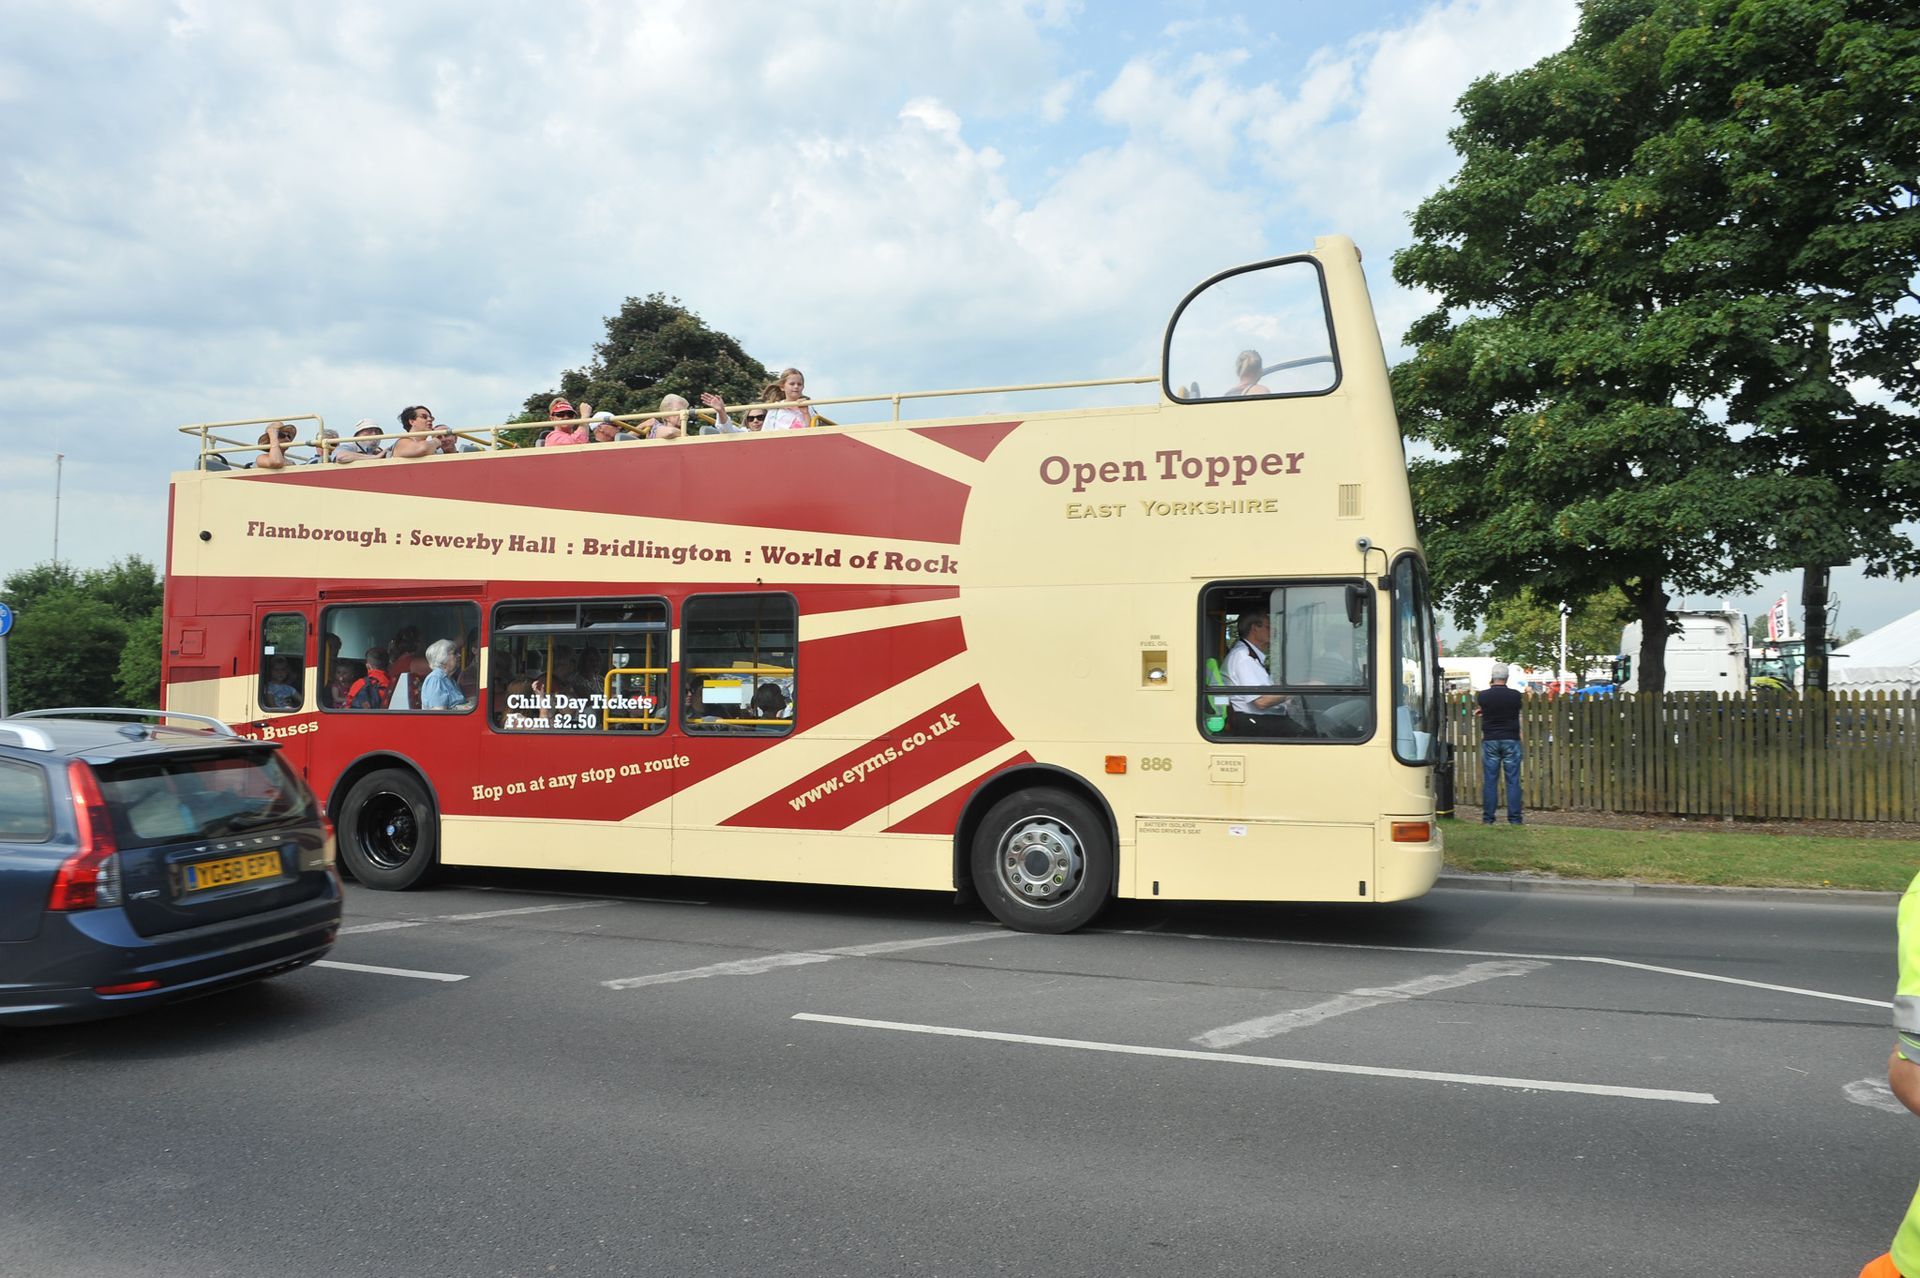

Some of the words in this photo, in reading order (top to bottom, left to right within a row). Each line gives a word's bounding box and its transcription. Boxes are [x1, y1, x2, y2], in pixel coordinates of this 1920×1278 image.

[1039, 456, 1148, 493] Open
[1155, 450, 1305, 487] Topper
[1065, 502, 1126, 520] EAST
[1139, 498, 1279, 517] YORKSHIRE
[246, 521, 387, 547] Flamborough
[409, 529, 504, 555] Sewerby
[508, 534, 556, 554] Hall
[582, 538, 732, 565] Bridlington
[760, 545, 842, 568] World
[849, 551, 879, 569] of
[883, 552, 959, 574] Rock
[506, 694, 552, 710] Child
[555, 694, 589, 713] Day
[262, 720, 319, 741] Buses
[505, 714, 550, 729] From
[553, 713, 597, 729] £2.50
[788, 711, 961, 812] www.eyms.co.uk
[1140, 757, 1172, 772] 886
[472, 784, 503, 801] Hop
[506, 781, 526, 796] on
[529, 776, 545, 791] at
[548, 773, 578, 790] any
[581, 765, 616, 784] stop
[619, 762, 641, 777] on
[644, 753, 691, 774] route
